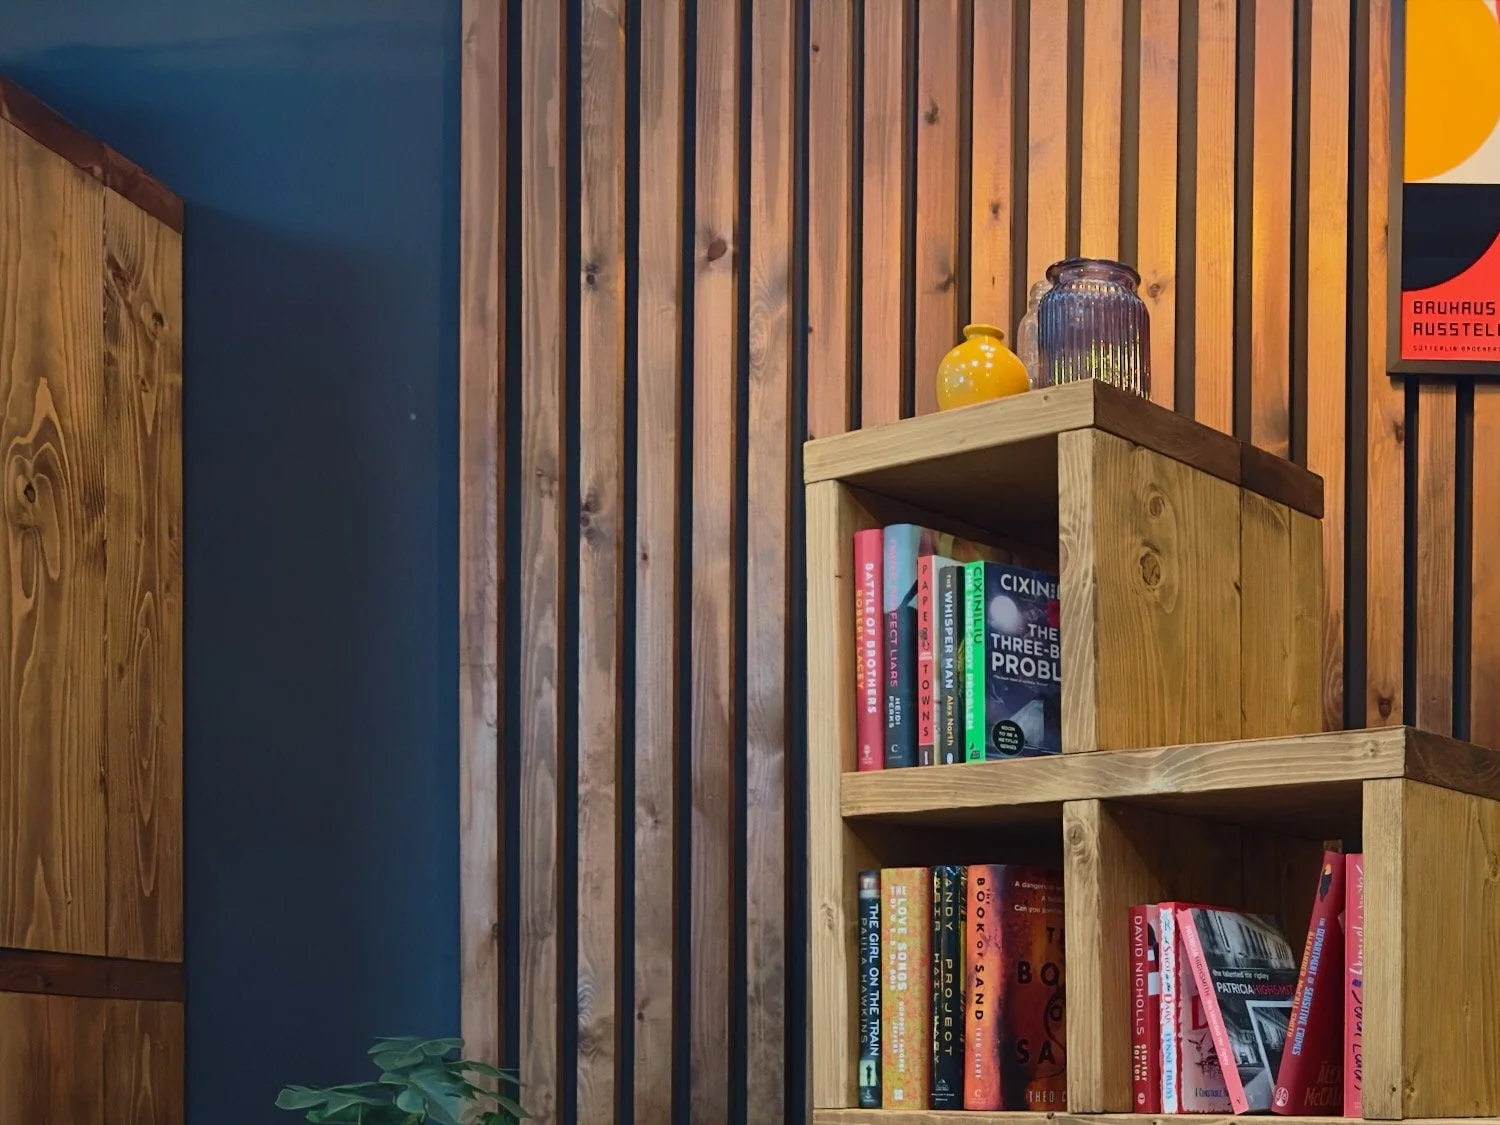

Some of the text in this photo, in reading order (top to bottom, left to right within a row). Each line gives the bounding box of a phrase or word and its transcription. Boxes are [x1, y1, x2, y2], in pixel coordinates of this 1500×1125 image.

[1413, 301, 1496, 316] BAUHAUS
[1000, 573, 1050, 599] CIXIN
[1028, 623, 1059, 642] THE
[864, 562, 877, 714] BATTLE OF BROTHERS
[889, 585, 898, 687] PERFECT LIARS
[944, 591, 954, 689] WHISPER MAN
[920, 664, 930, 737] TOWNS
[946, 718, 954, 746] North
[860, 918, 868, 1044] PAULA HAWKINS
[869, 903, 879, 1056] THE GIRL ON THE TRAIN
[896, 898, 907, 991] LOVE SONGS
[975, 877, 985, 1020] BOOK SAND
[1134, 915, 1145, 1036] DAVID NICHOLLS
[1216, 982, 1255, 994] PATRICIA
[1298, 928, 1325, 1025] DEPARTMENT SENSITIVE
[944, 958, 954, 1057] PROJECT
[1140, 1044, 1148, 1081] starter
[1165, 1033, 1174, 1099] LYNNE TRUSS
